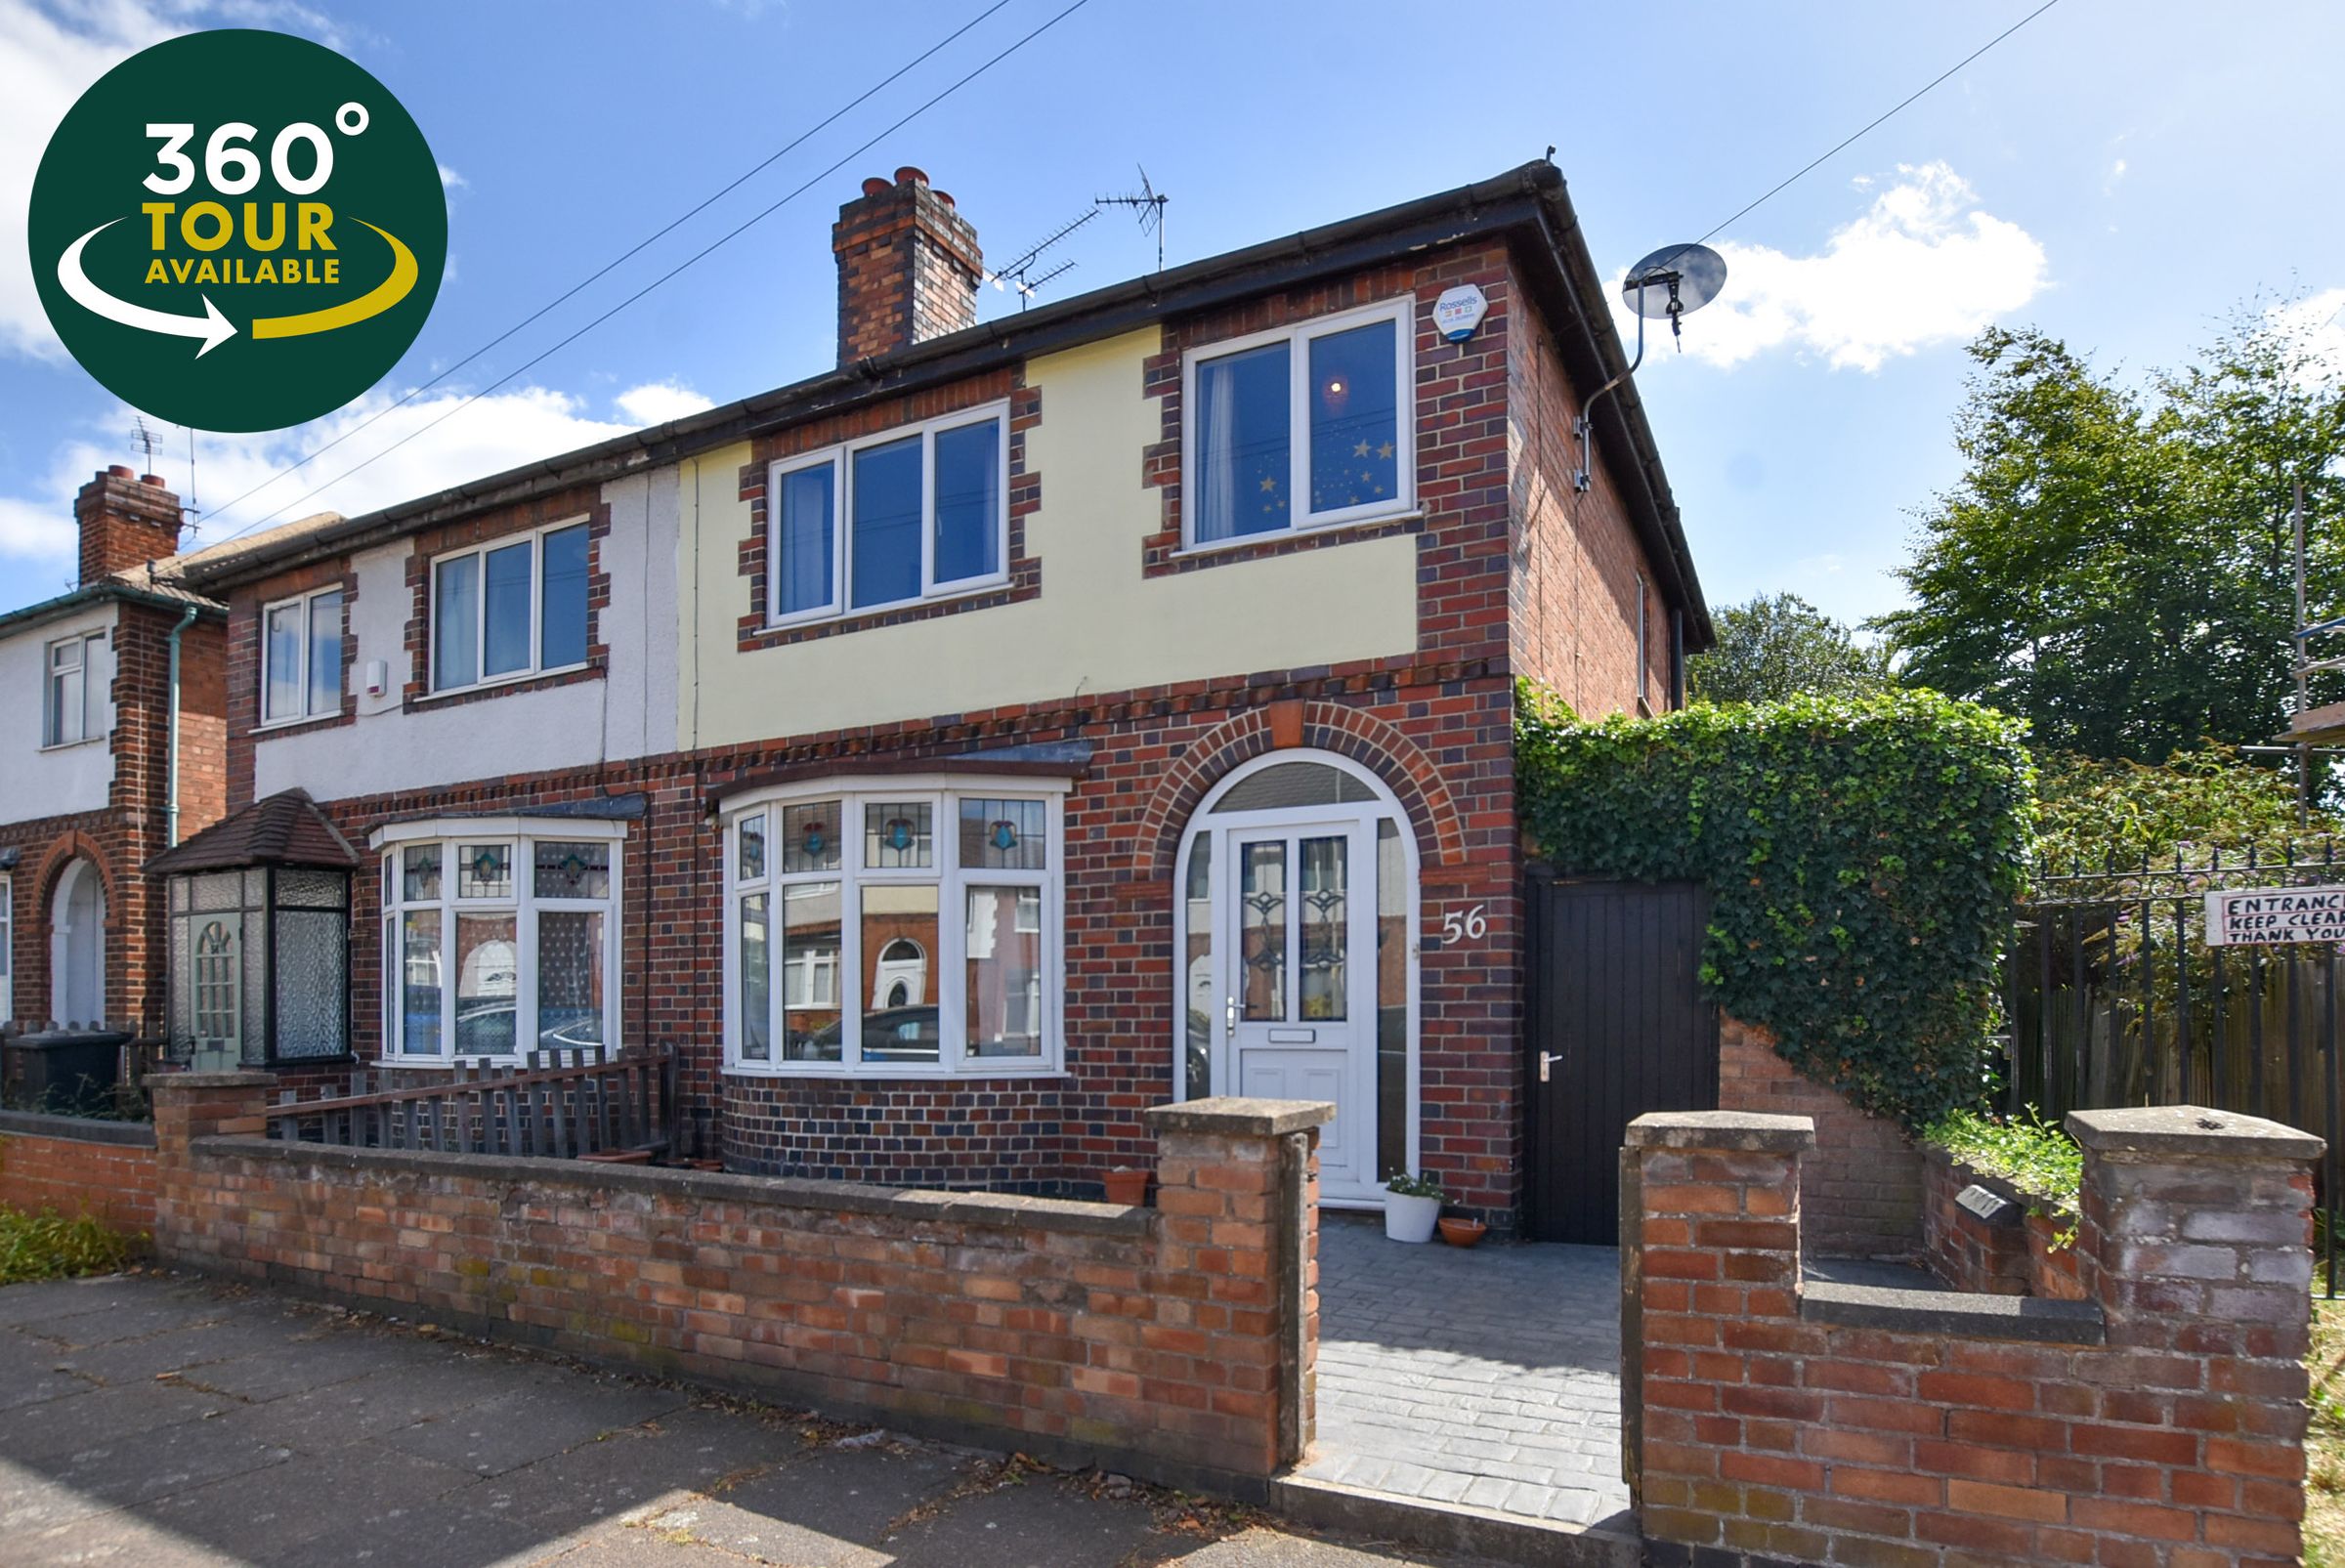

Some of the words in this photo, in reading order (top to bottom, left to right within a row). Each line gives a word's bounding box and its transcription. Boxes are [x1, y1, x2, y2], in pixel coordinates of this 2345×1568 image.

[1439, 296, 1478, 312] Rossells
[2228, 894, 2345, 915] ENTRANC
[1441, 905, 1486, 945] 56
[2230, 914, 2278, 930] KEEP
[2229, 928, 2294, 943] THANK
[2306, 927, 2345, 940] YOU
